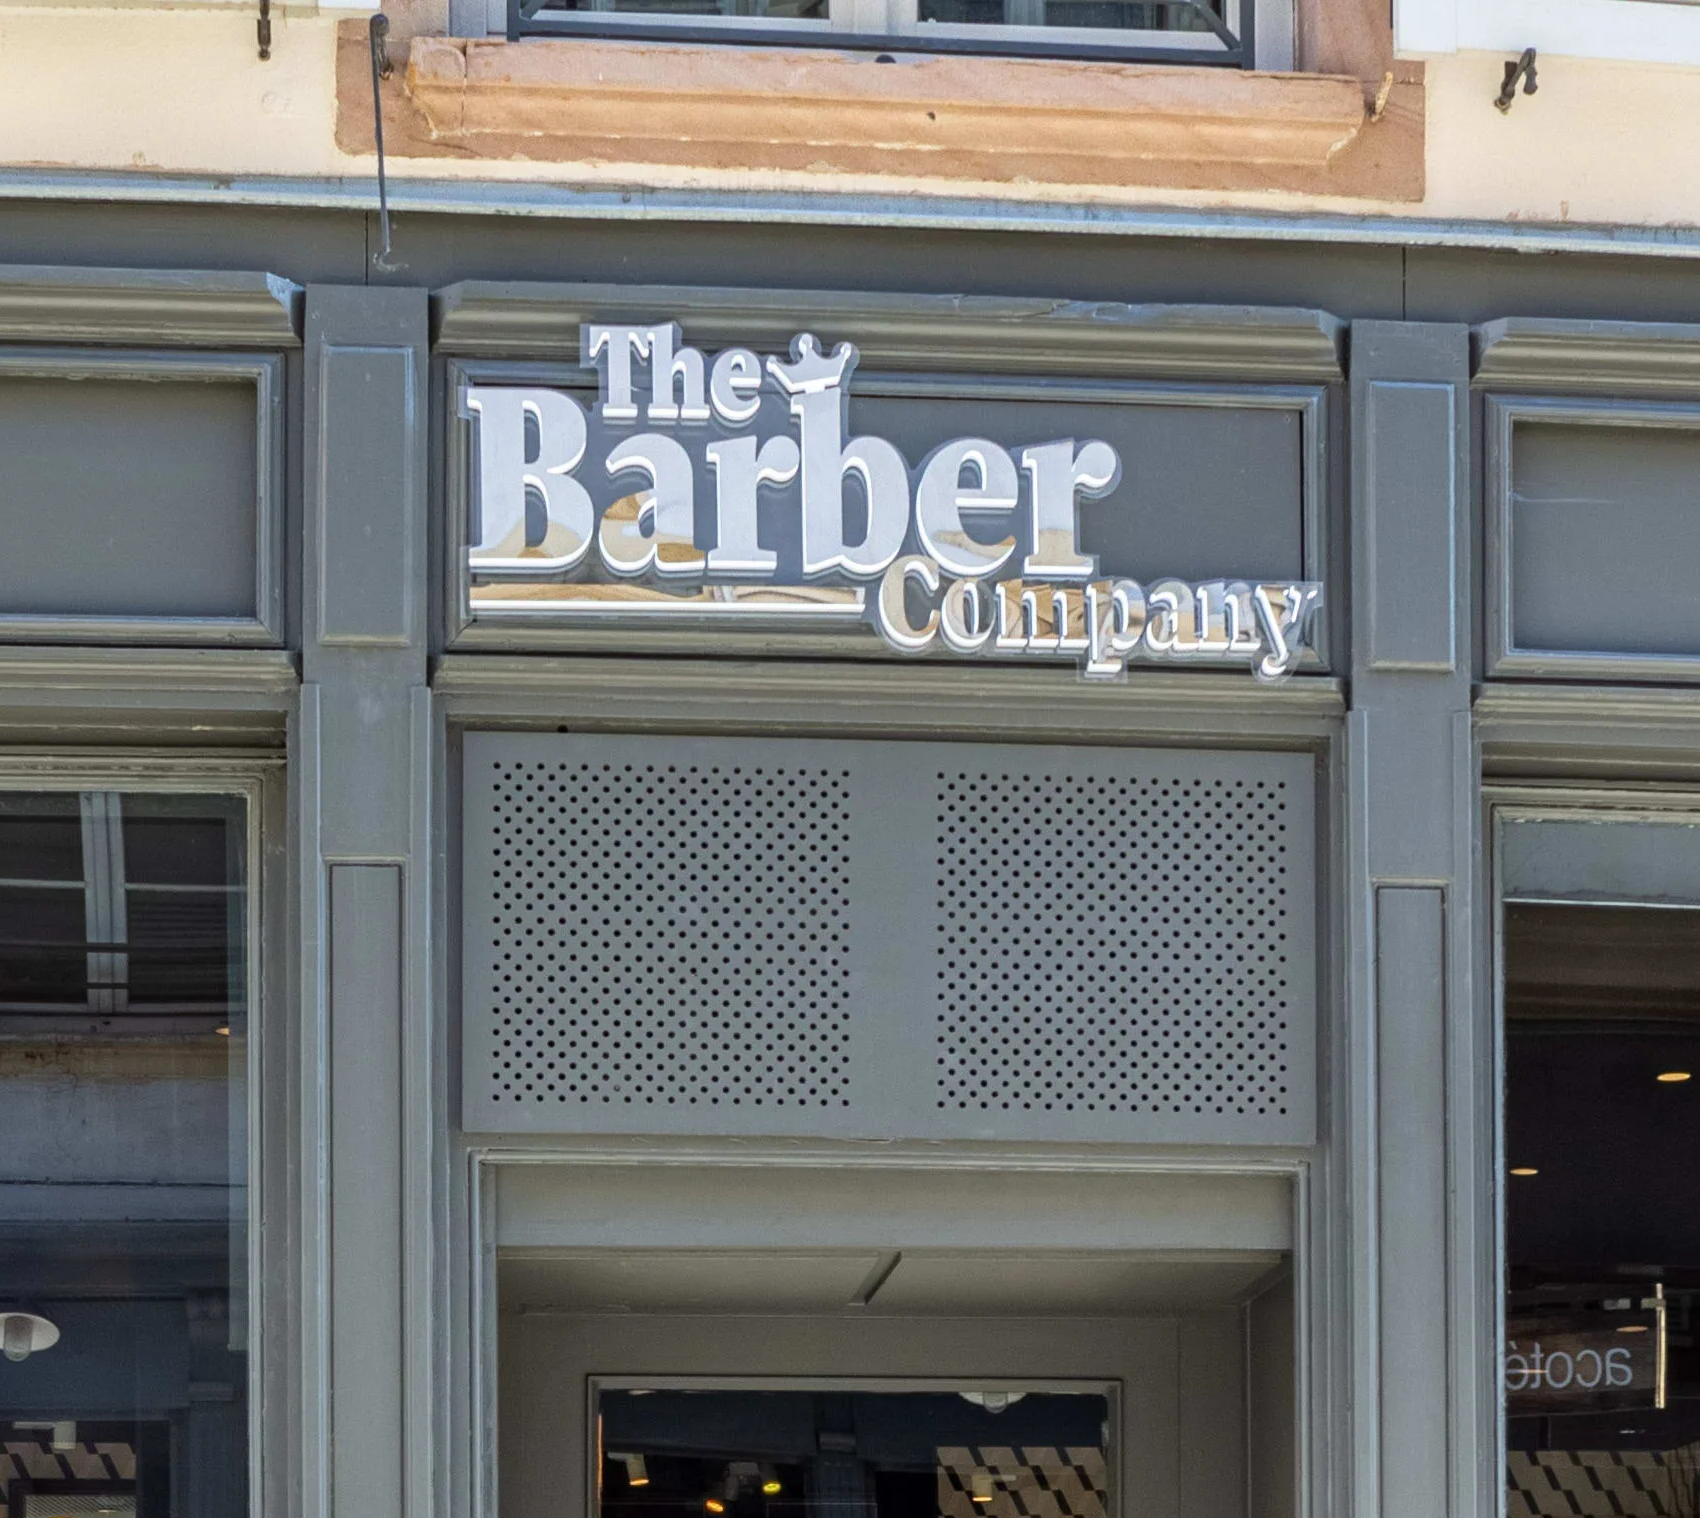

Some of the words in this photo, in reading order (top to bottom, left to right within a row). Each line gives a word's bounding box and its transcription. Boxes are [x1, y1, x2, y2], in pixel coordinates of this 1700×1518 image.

[587, 324, 765, 424] The
[467, 384, 1119, 578] Barber
[877, 555, 1317, 677] Company
